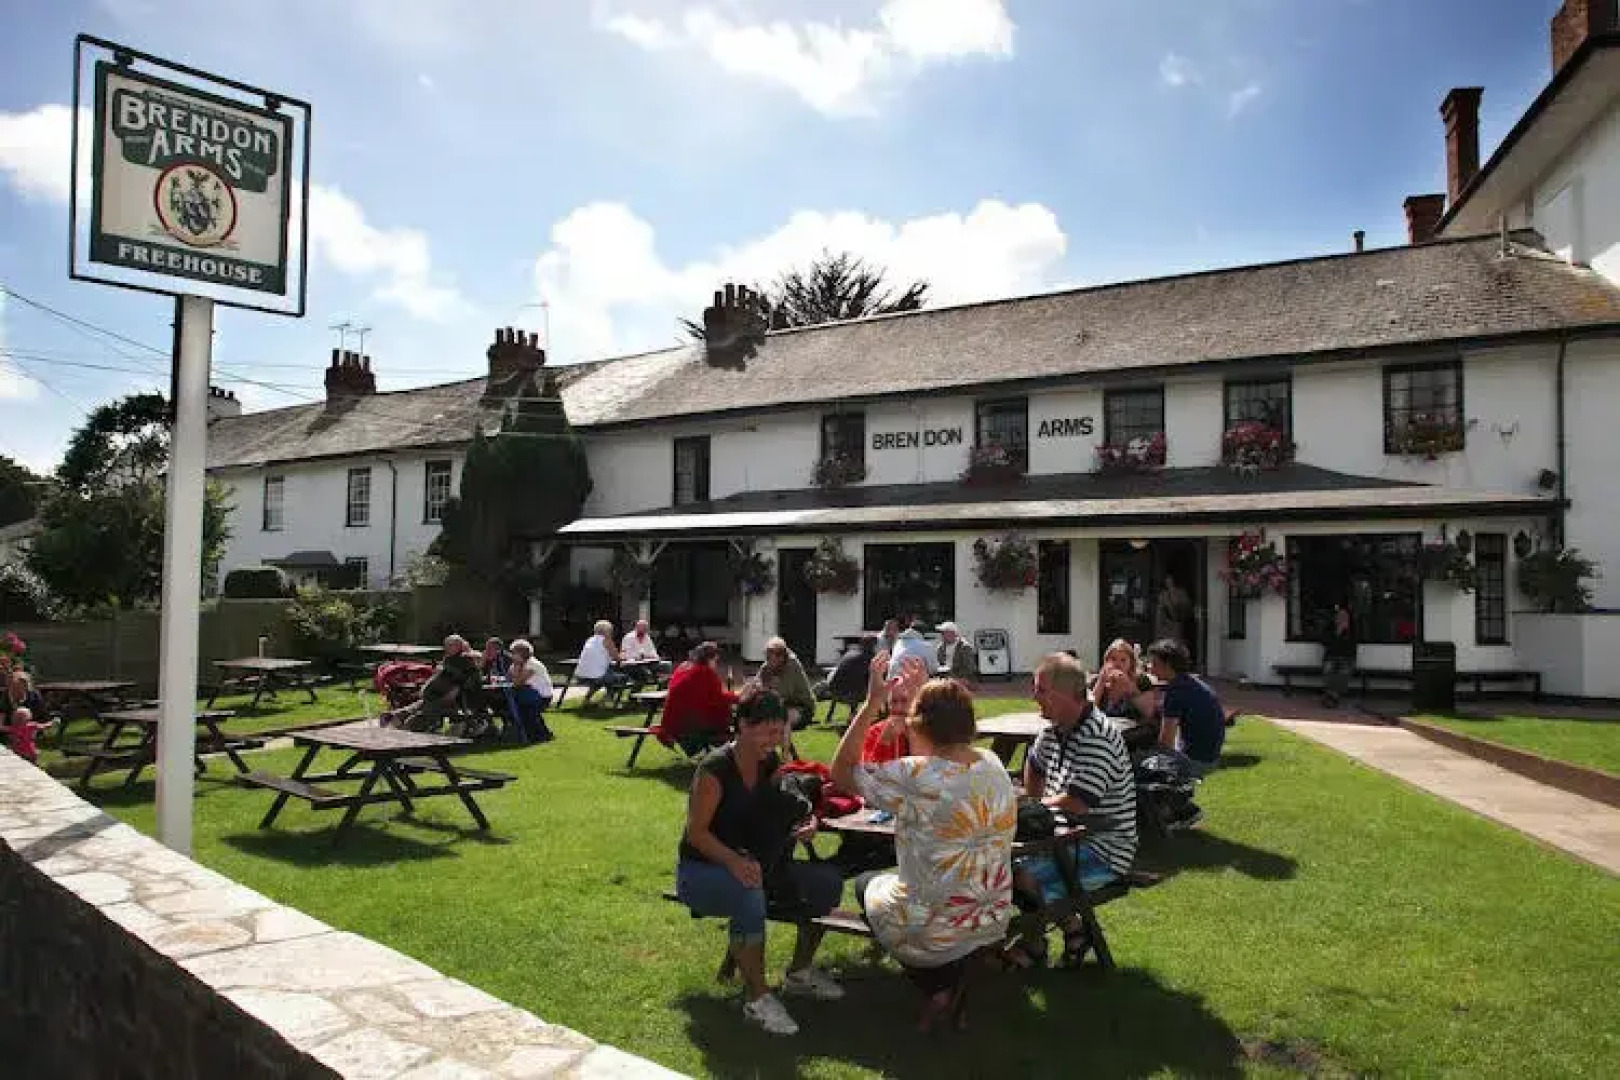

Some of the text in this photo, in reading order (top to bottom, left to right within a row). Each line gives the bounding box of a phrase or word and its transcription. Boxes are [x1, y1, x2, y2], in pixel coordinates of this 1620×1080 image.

[121, 96, 270, 154] BRENDON
[148, 130, 242, 180] ARMS
[118, 243, 263, 284] FREEHOUSE
[873, 417, 1094, 450] BRENDON ARMS
